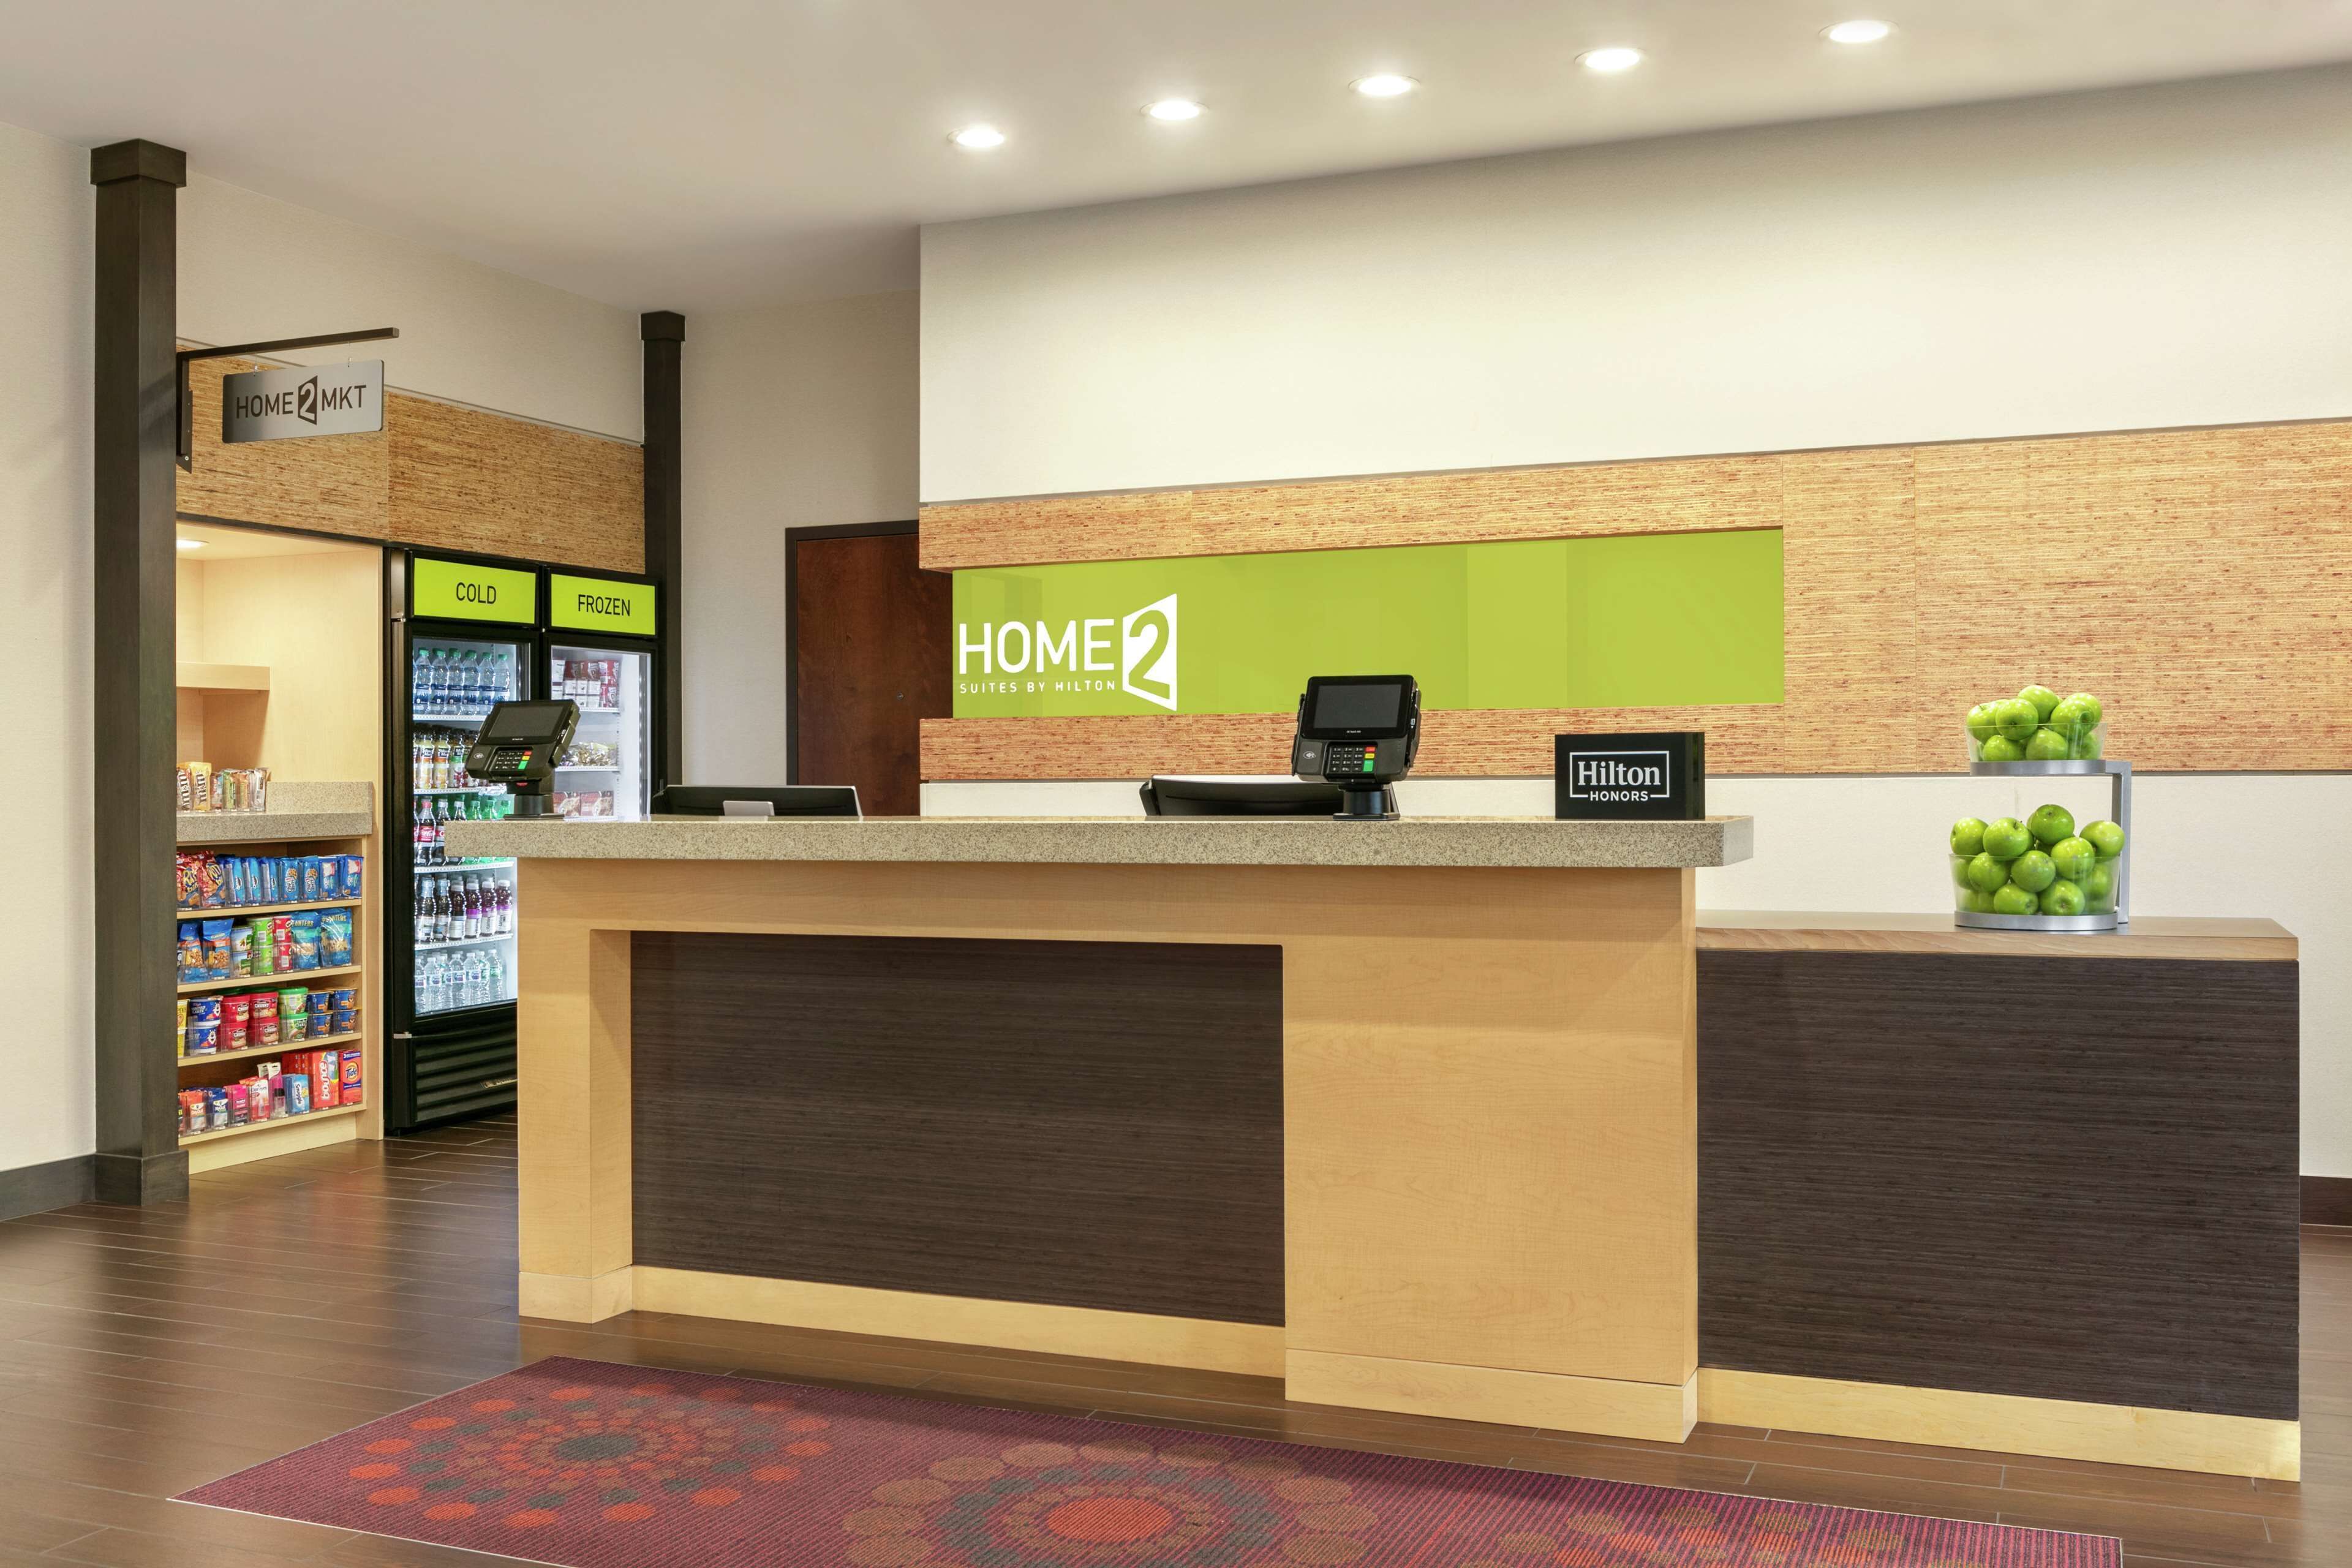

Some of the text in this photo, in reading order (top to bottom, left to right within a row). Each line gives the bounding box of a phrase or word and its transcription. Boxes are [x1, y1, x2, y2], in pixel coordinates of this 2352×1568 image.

[456, 582, 497, 605] COLD
[578, 594, 631, 617] FROZEN
[960, 680, 1115, 694] SUITES BY HILTON
[1577, 761, 1662, 786] Hilton
[1589, 791, 1649, 802] HONORS
[320, 1061, 331, 1101] bounce
[345, 1068, 357, 1079] Tide
